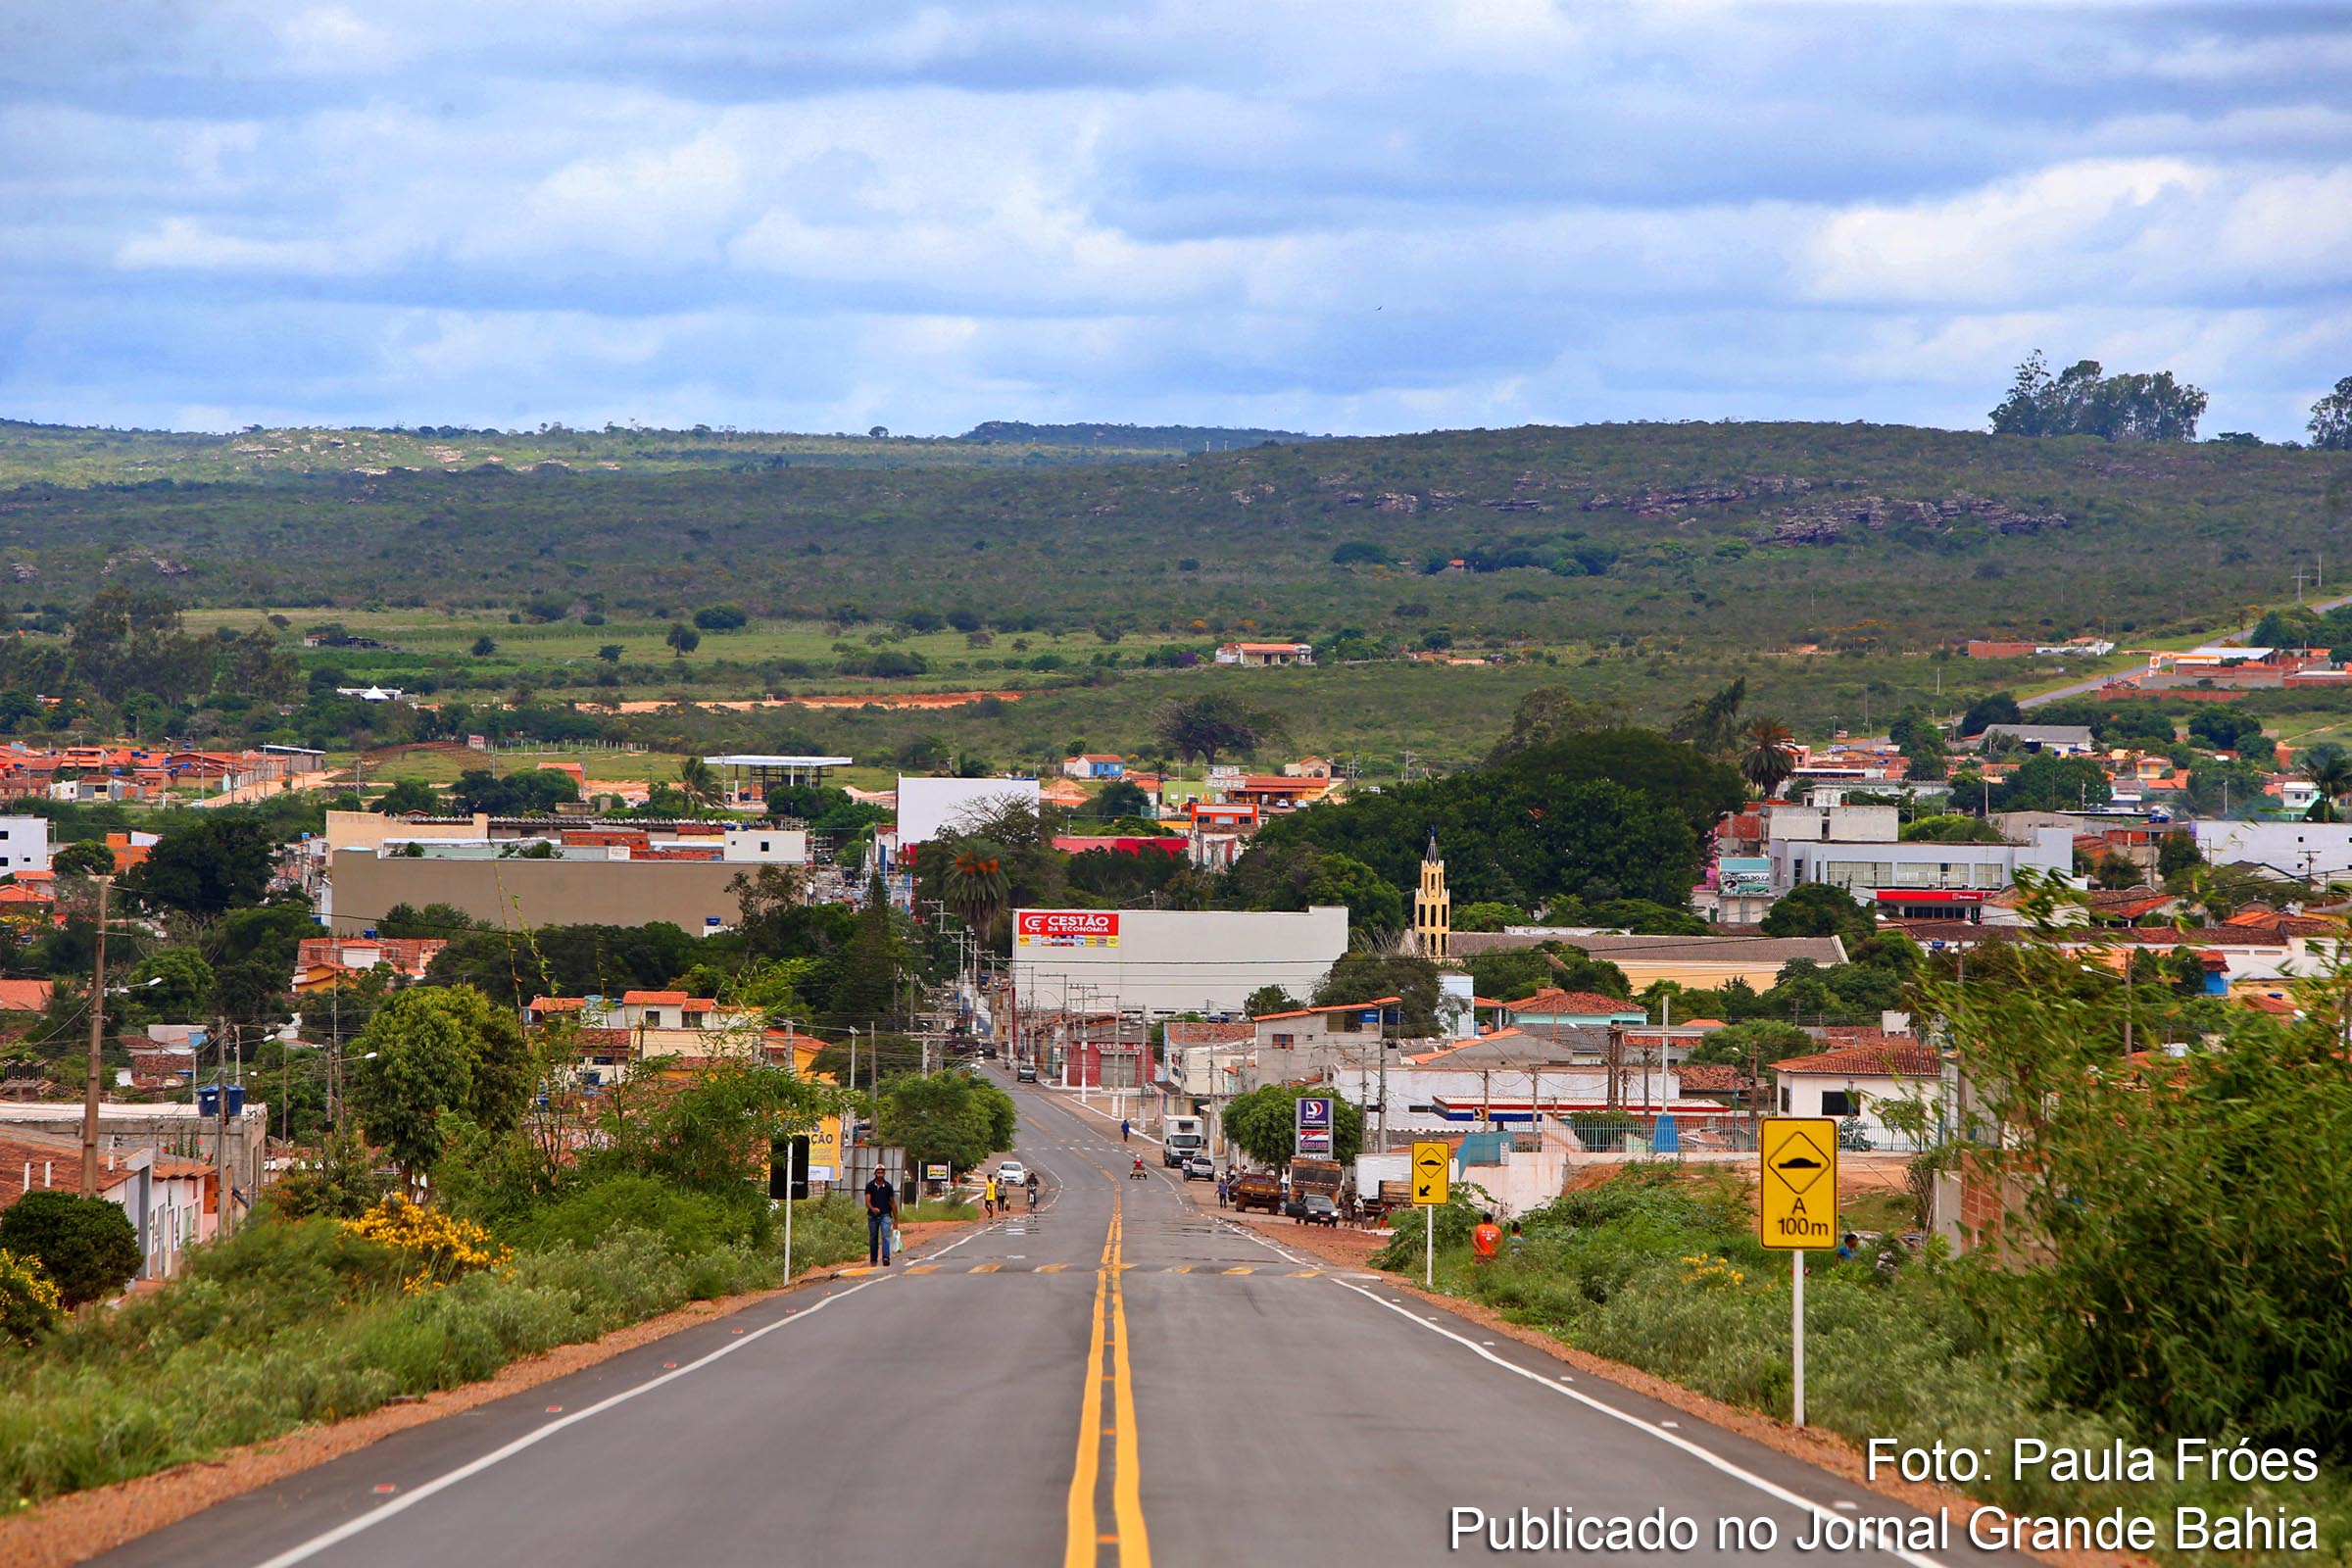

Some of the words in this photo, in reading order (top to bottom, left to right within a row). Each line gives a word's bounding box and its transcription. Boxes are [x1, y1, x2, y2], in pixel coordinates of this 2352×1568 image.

[1048, 913, 1109, 926] CESTÃO
[808, 1131, 833, 1146] ÇÃO
[1792, 1198, 1806, 1214] A
[1778, 1217, 1829, 1236] 100m
